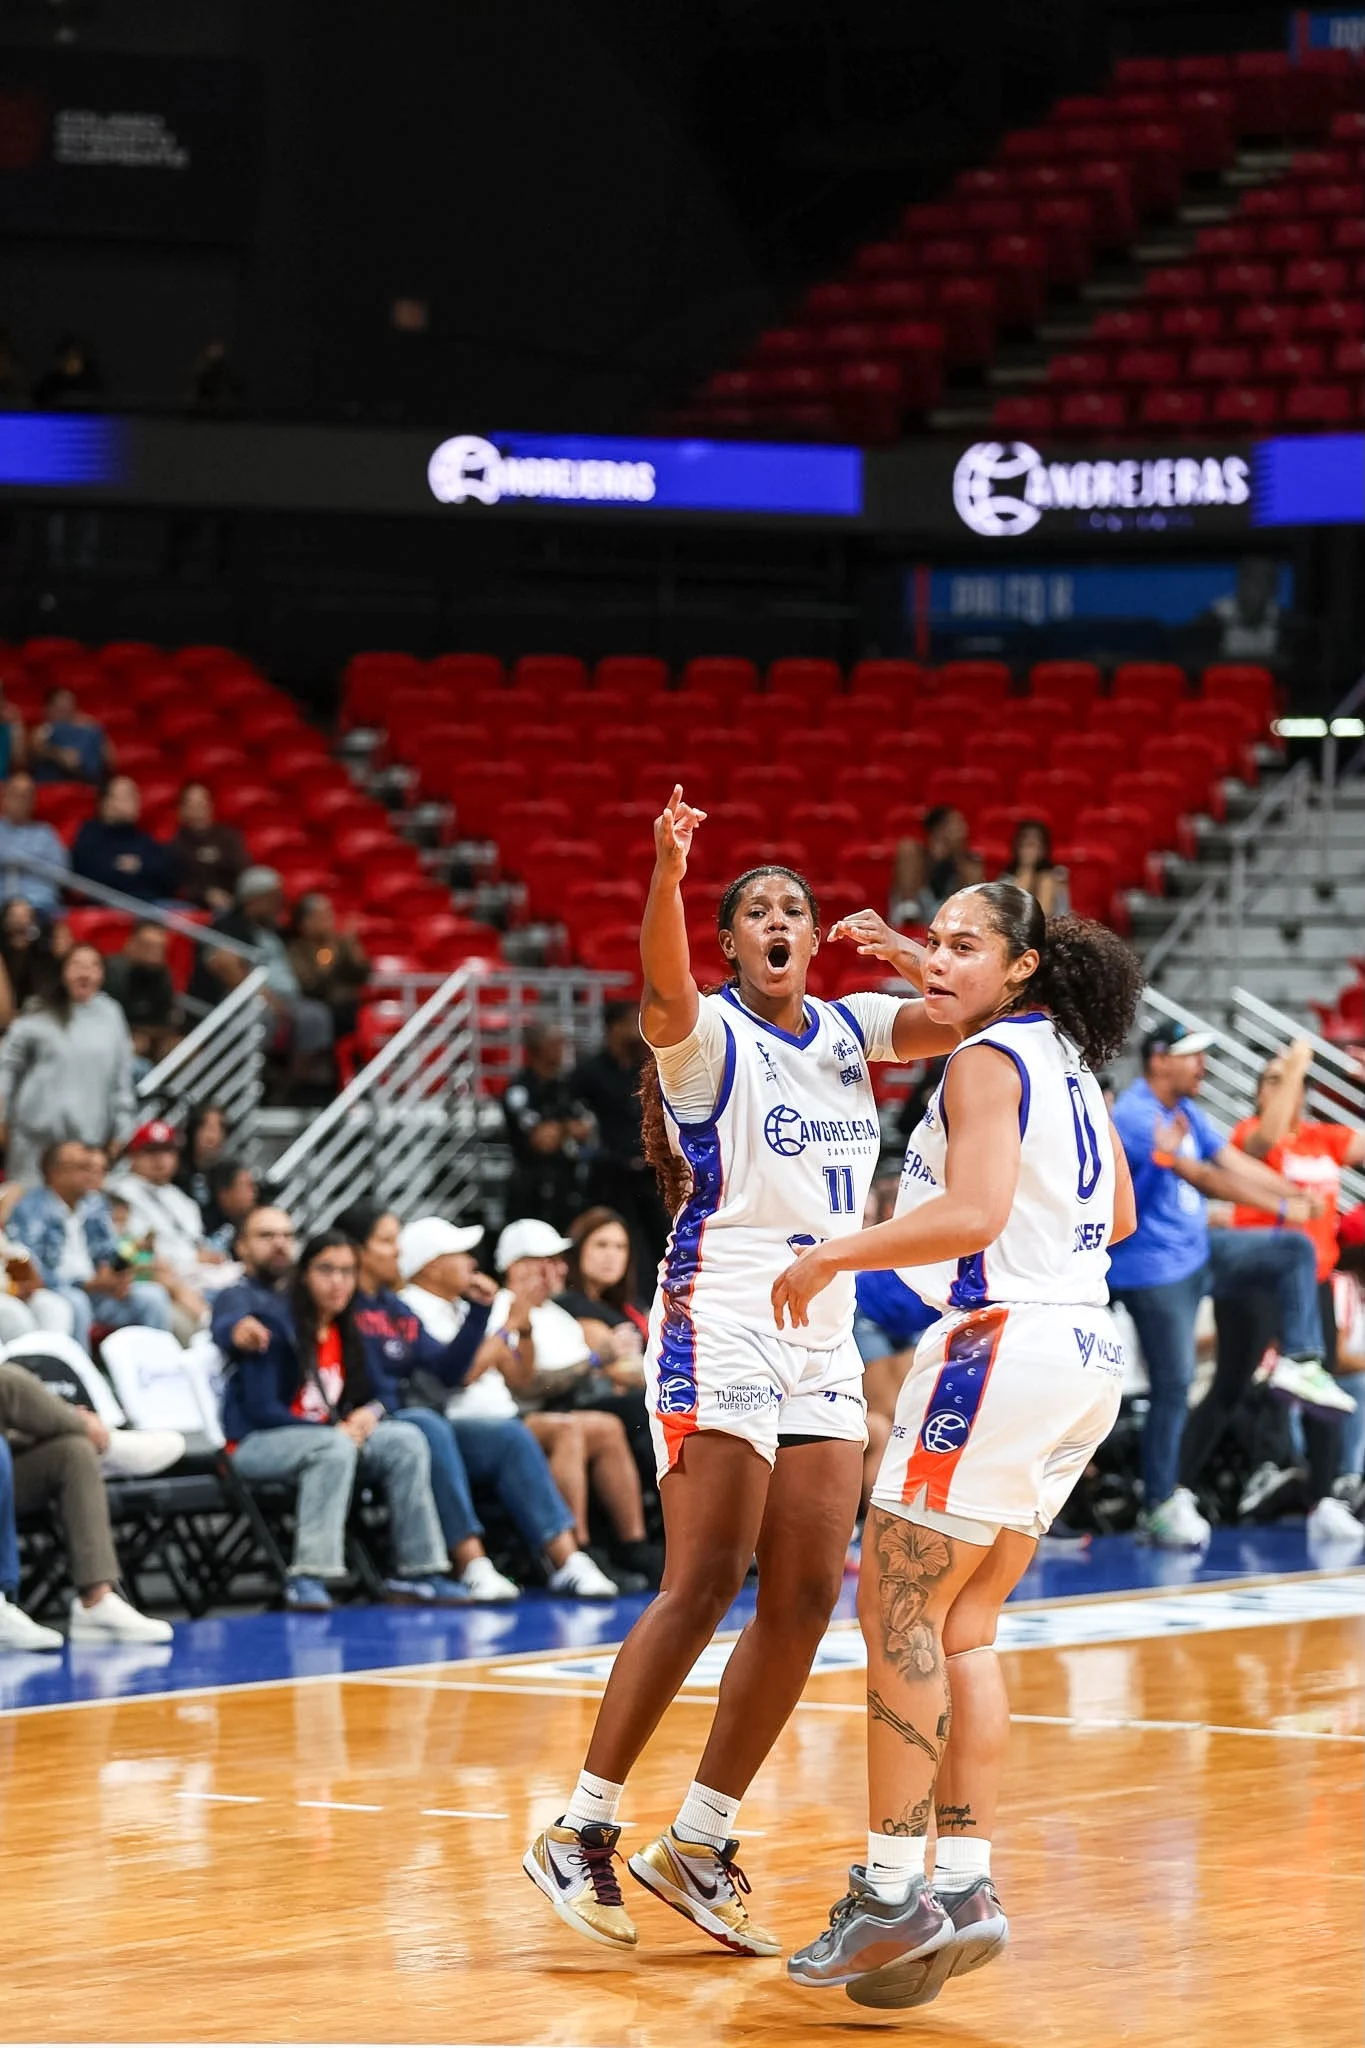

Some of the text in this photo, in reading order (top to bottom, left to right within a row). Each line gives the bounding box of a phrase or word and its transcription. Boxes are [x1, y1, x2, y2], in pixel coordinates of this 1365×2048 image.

[764, 1104, 879, 1157] CANGREJERA
[1064, 1072, 1102, 1204] 0
[827, 1146, 872, 1157] SANTURCE
[822, 1165, 856, 1214] 11
[1072, 1223, 1106, 1253] NES
[714, 1390, 770, 1405] TURISMO
[719, 1402, 751, 1411] PUERTO
